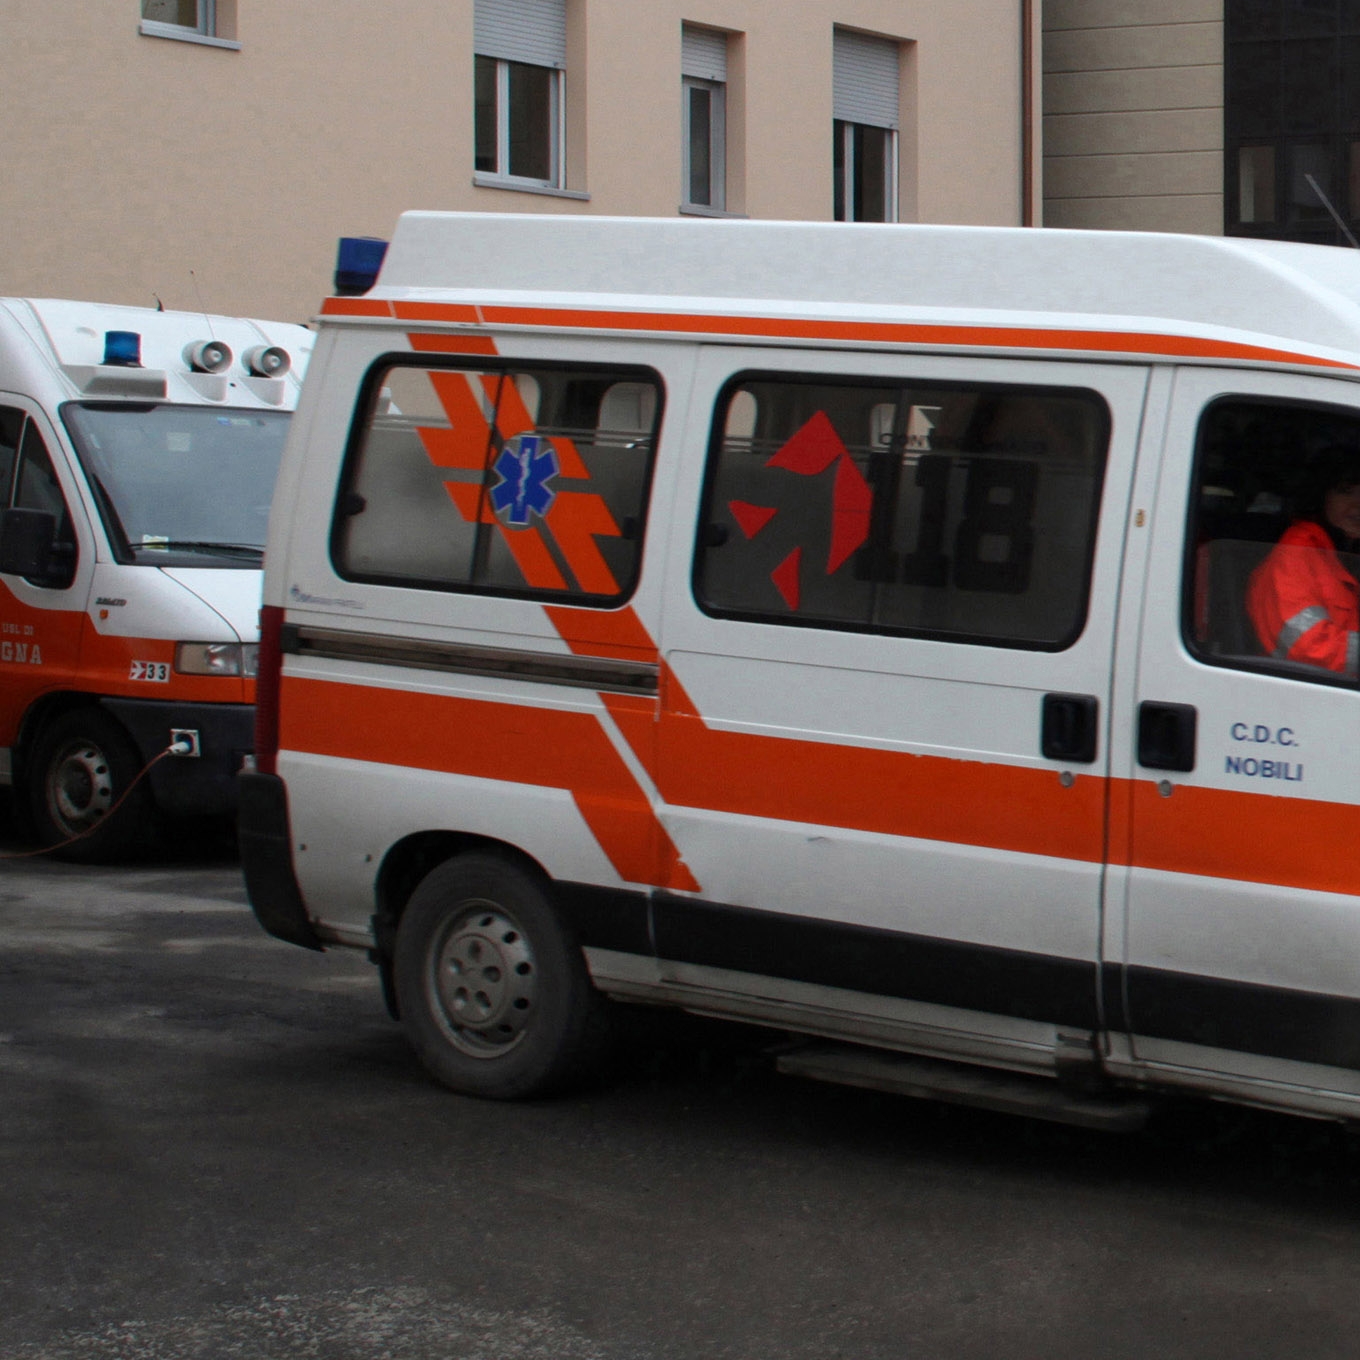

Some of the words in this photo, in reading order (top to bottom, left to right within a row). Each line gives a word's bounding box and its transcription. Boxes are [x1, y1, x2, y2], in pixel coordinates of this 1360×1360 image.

[855, 453, 1037, 593] 118
[146, 663, 167, 680] 33
[1231, 722, 1299, 747] C.D.C.
[1224, 755, 1304, 782] NOBILI
